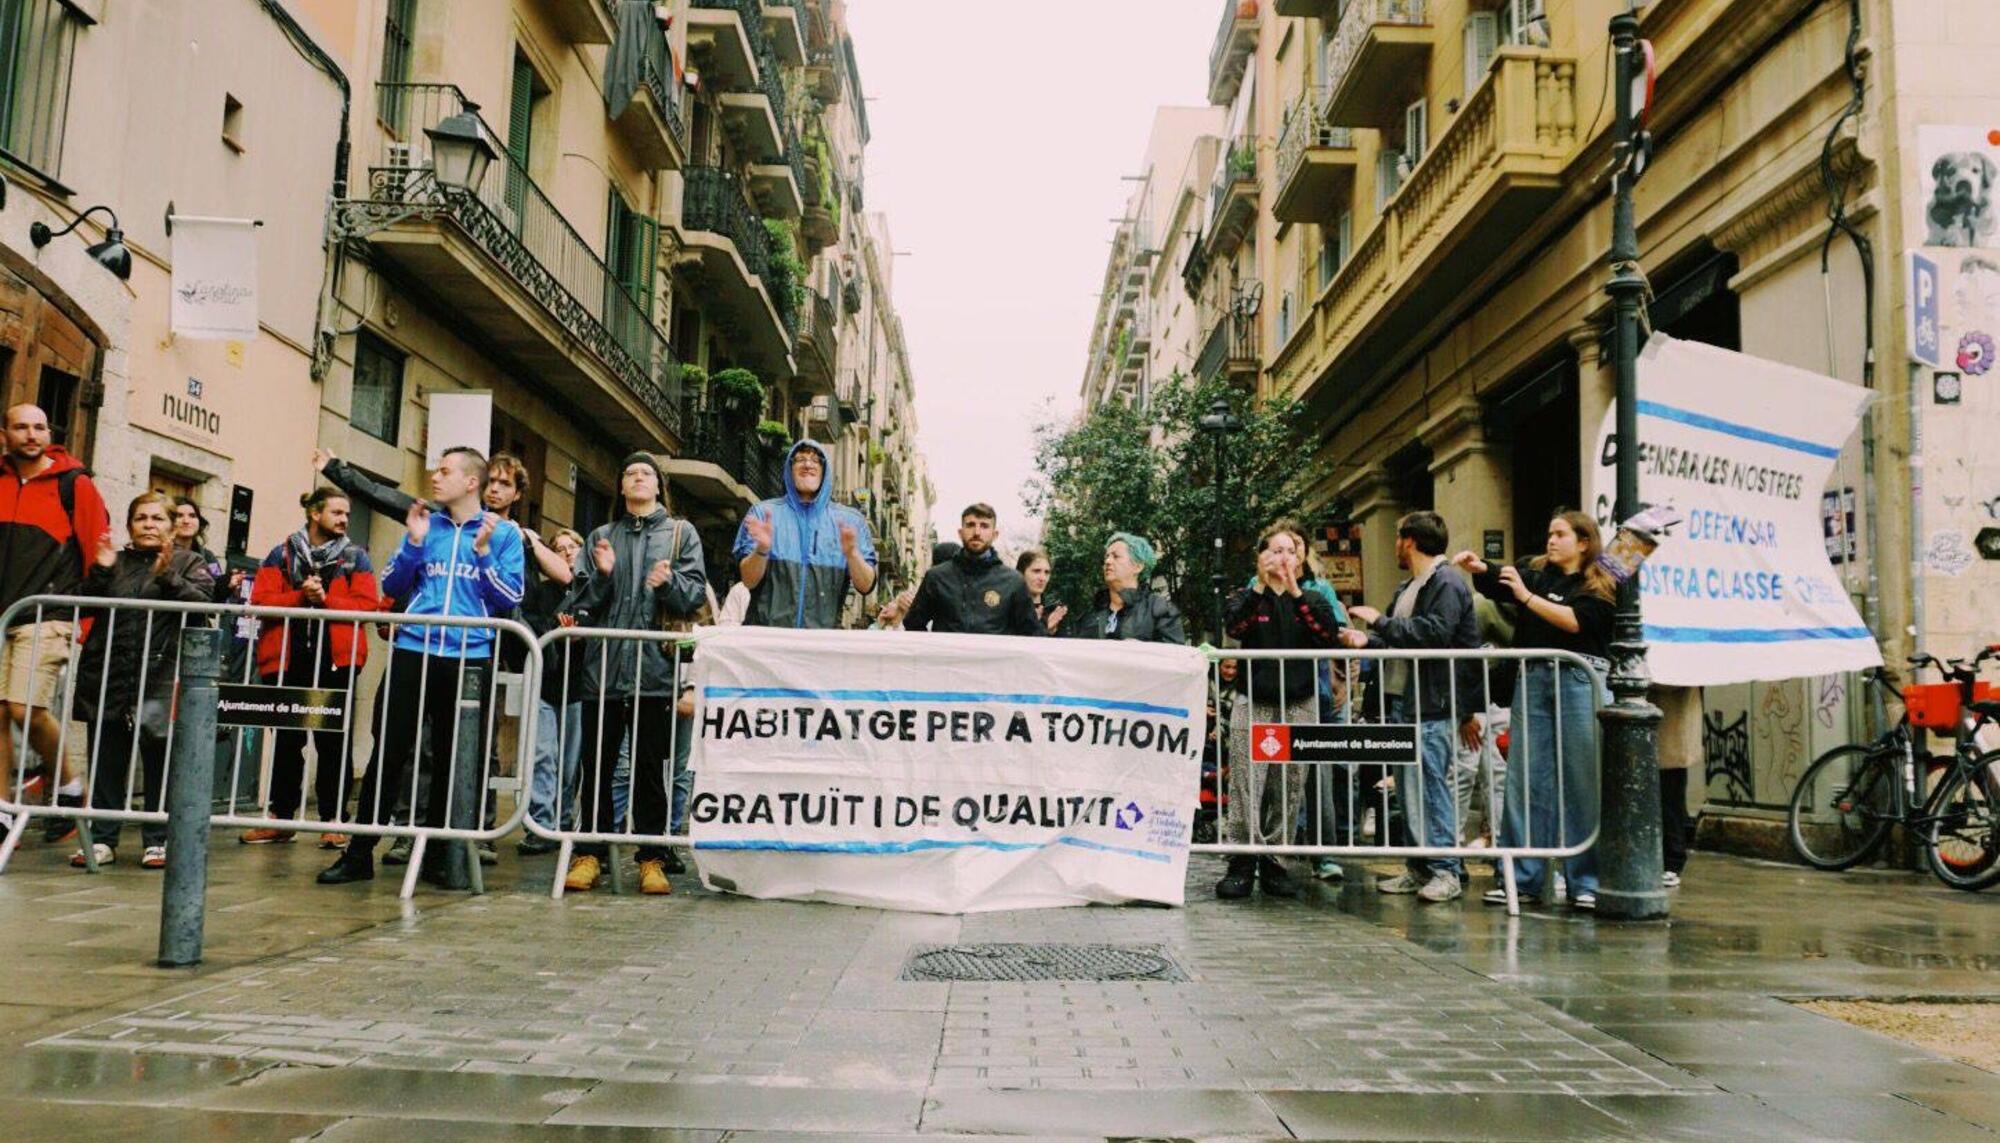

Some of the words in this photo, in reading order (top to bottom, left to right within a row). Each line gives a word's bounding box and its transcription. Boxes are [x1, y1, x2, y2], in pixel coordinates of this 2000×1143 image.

[1919, 268, 1933, 307] P
[162, 393, 220, 435] numa
[1731, 463, 1803, 500] NOSTRES
[1688, 508, 1778, 548] DEFENSAR
[1706, 567, 1783, 600] CLASSE
[217, 699, 274, 712] Ajuntament
[276, 702, 289, 713] de
[291, 703, 342, 715] Barcelona
[701, 706, 917, 742] HABITATGE
[927, 710, 995, 743] PER
[1005, 710, 1032, 743] A
[1041, 711, 1198, 760] TOTHOM,
[1293, 738, 1348, 750] Ajuntament
[1350, 739, 1362, 749] de
[1364, 739, 1413, 749] Barcelona
[691, 787, 864, 826] GRATUÏT
[874, 795, 883, 828] I
[895, 795, 940, 827] DE
[952, 794, 1115, 832] QUALITAT
